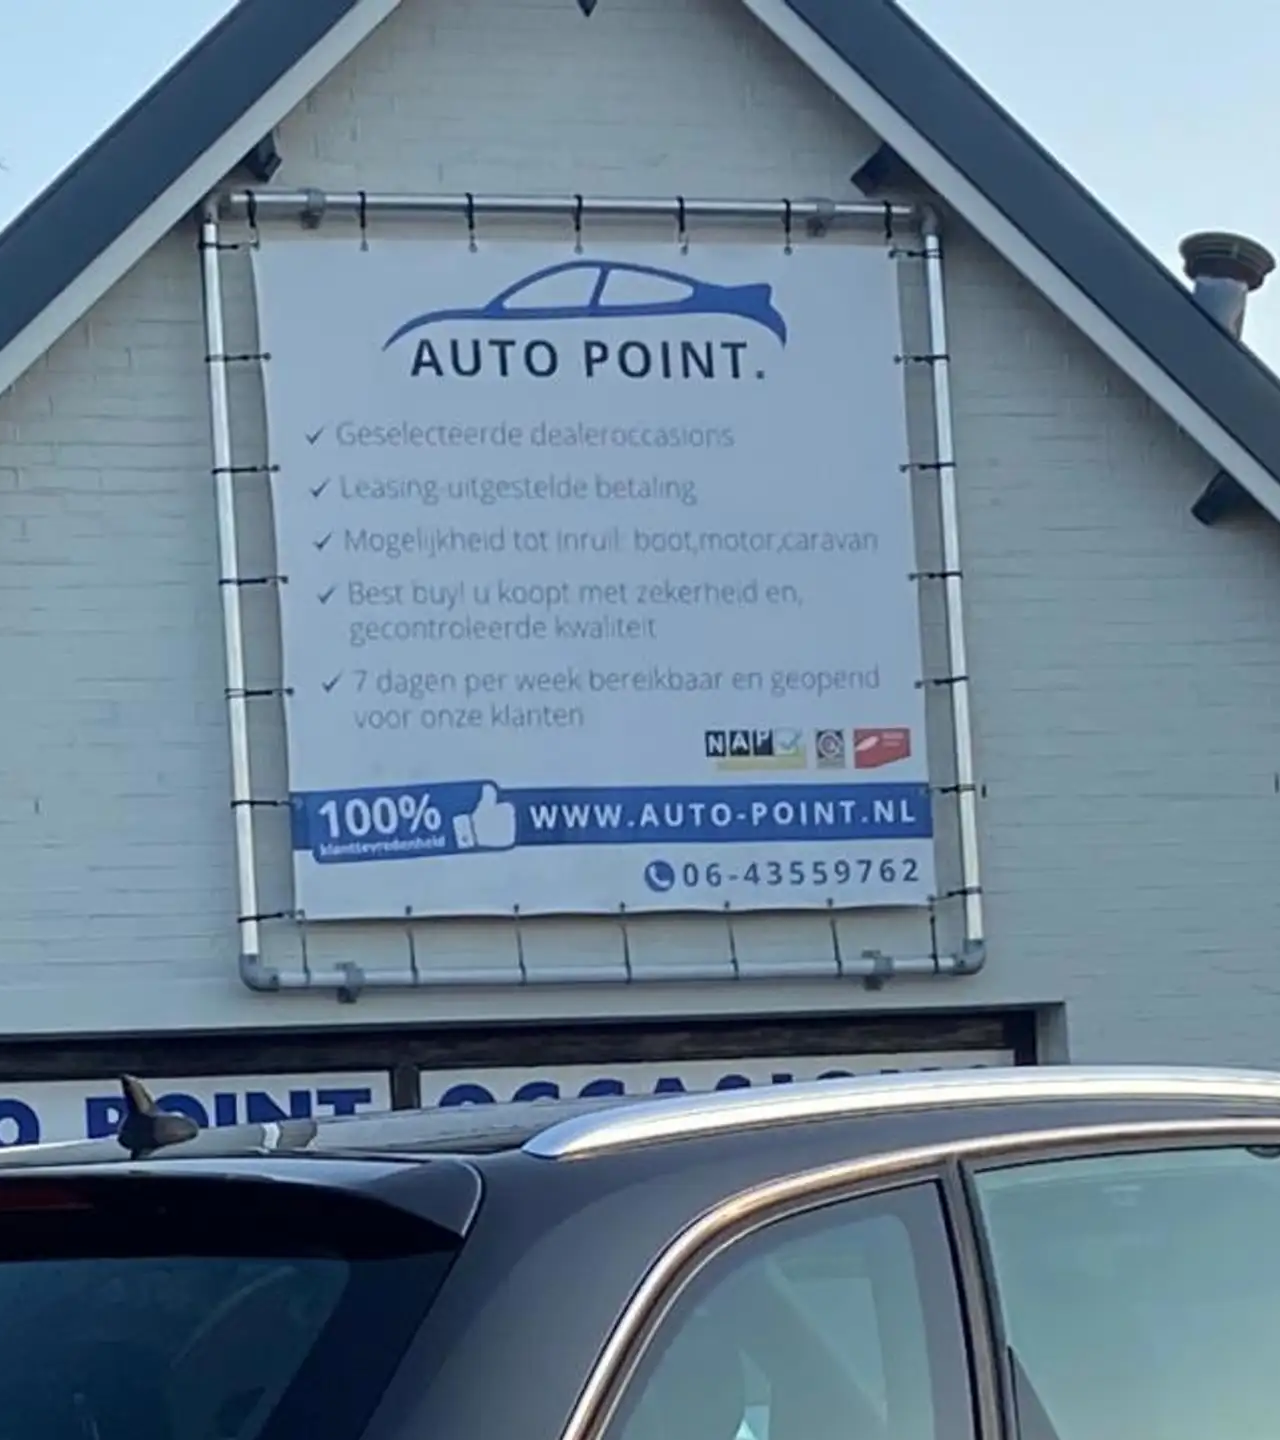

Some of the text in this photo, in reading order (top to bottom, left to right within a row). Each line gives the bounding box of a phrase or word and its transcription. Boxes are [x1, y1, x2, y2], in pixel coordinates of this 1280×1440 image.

[411, 338, 765, 380] AUTO POINT.
[335, 420, 735, 447] Geselecteerde dealeroccasions
[596, 473, 698, 506] betaling
[344, 526, 505, 559] Mogelijkheid
[513, 528, 549, 552] tot
[348, 580, 403, 606] Best
[473, 584, 490, 605] u
[499, 579, 569, 610] koopt
[579, 582, 627, 605] met
[636, 578, 758, 606] zekerheid
[349, 614, 657, 647] gecontroleerde kwaliteit
[353, 665, 880, 700] 7 dagen per week bereikbaar en geopend
[353, 703, 584, 730] voor onze klanten
[706, 729, 773, 755] NAP
[318, 793, 442, 838] 100%
[529, 799, 916, 830] WWW.AUTO-POINT.NL
[682, 858, 920, 888] 06-43559762
